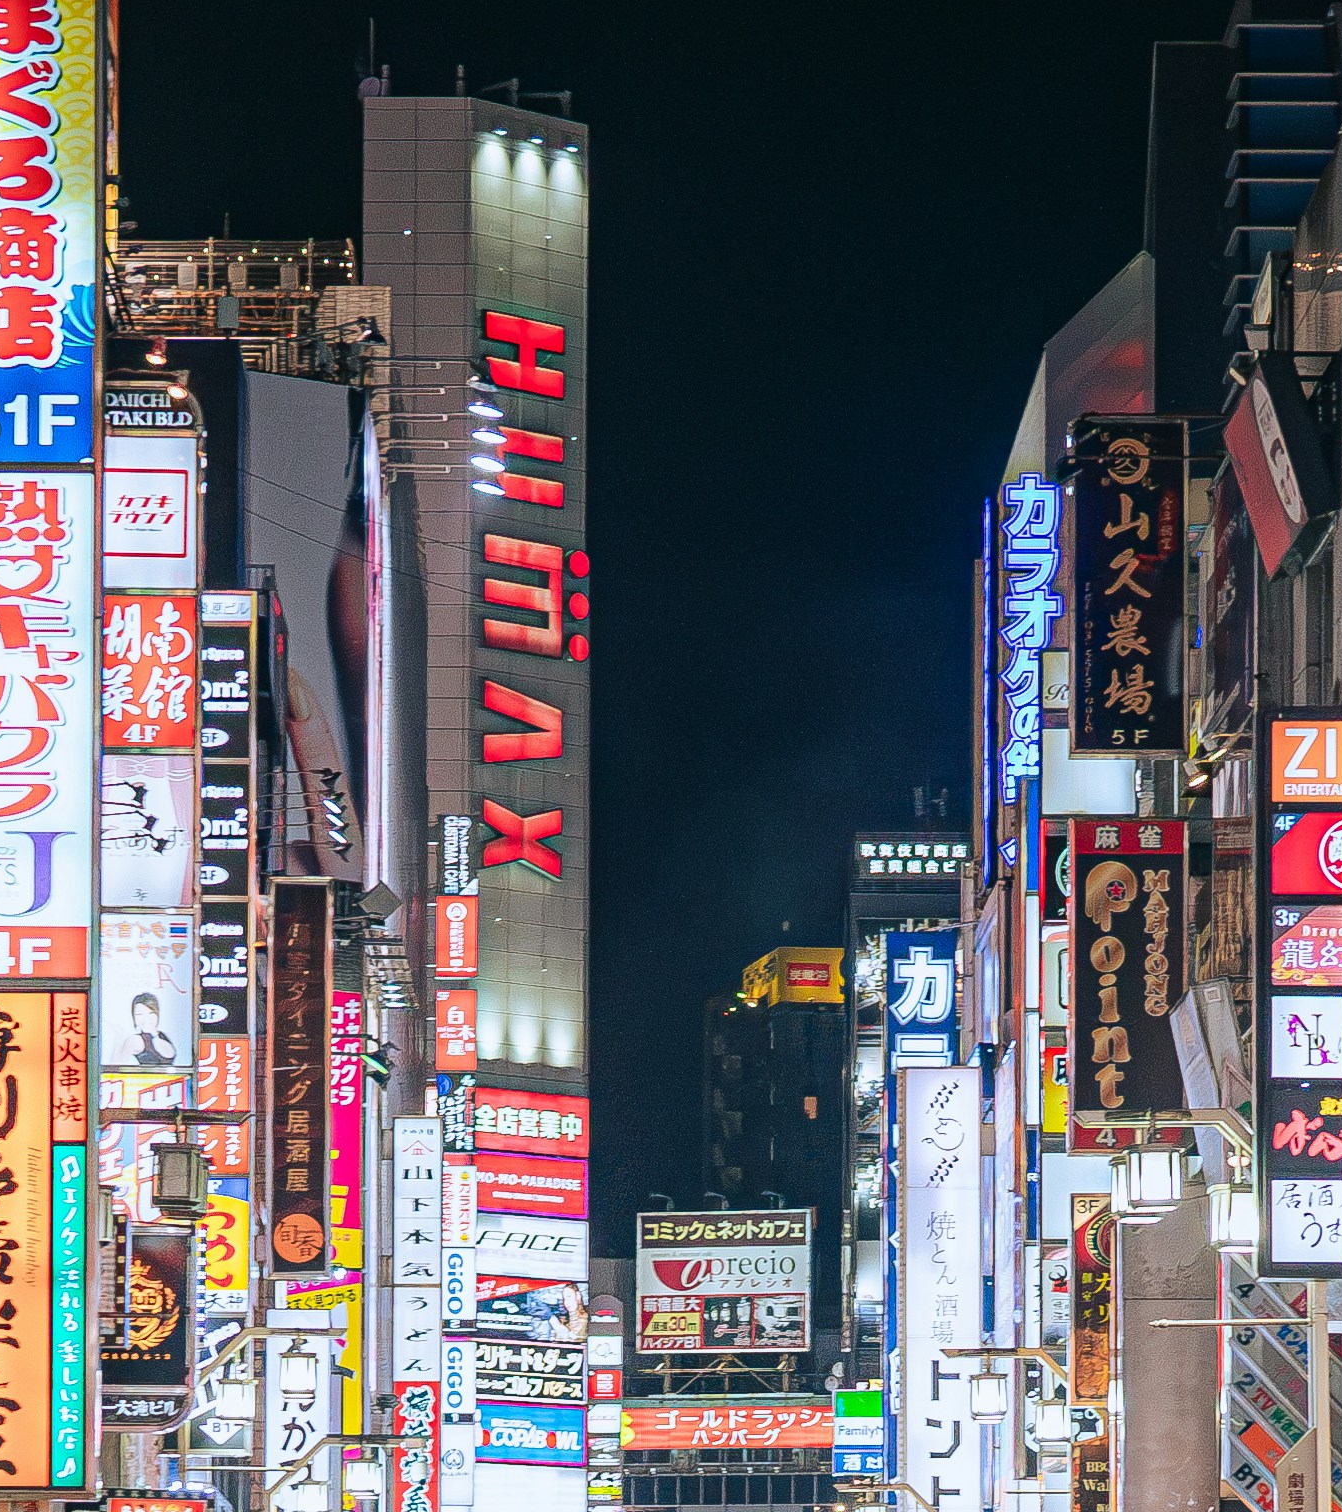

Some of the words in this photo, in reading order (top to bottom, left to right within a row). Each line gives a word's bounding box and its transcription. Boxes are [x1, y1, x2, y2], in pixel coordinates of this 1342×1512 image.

[105, 411, 152, 426] TAKI
[155, 411, 193, 426] BLD
[118, 494, 174, 508] カブキ
[109, 510, 179, 525] ラウンジ
[483, 310, 565, 879] HUMAX
[1102, 493, 1154, 716] 山久農場
[122, 723, 161, 743] 4F
[1110, 729, 1150, 746] 5F
[1274, 815, 1296, 832] 4F
[1093, 825, 1165, 851] 麻雀
[1274, 910, 1299, 927] 3F
[1143, 870, 1172, 1017] MAHJONG
[1085, 860, 1139, 1109] Point
[53, 1006, 85, 1122] 炭火串焼
[474, 1104, 583, 1142] 全店営業中
[1076, 1199, 1100, 1215] 3F
[476, 1230, 583, 1254] FACE
[644, 1221, 805, 1241] コミック&ネットカフェ
[401, 1164, 436, 1374] 山下本気うどん
[924, 1210, 958, 1345] 焼とん酒場
[447, 1252, 463, 1316] GiGO
[1236, 1325, 1256, 1346] 3
[447, 1346, 463, 1410] GiGO
[691, 1428, 782, 1447] ハンバーグ
[1231, 1462, 1260, 1491] B1
